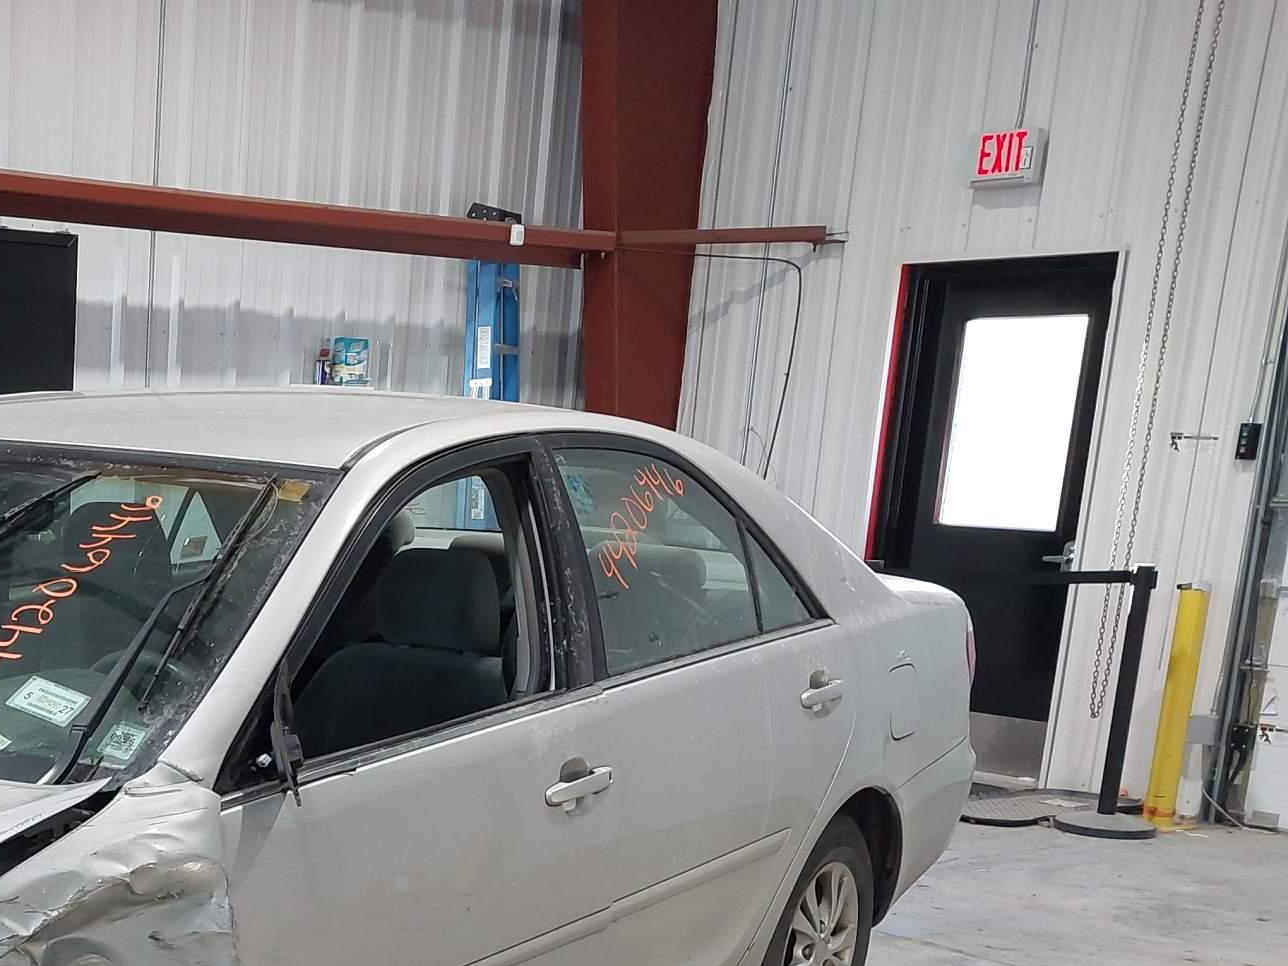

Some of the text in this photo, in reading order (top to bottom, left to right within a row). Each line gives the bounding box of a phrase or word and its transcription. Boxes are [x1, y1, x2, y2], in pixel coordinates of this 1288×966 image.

[976, 130, 1028, 175] EXIT
[598, 463, 685, 589] 44206446
[58, 704, 75, 715] 27
